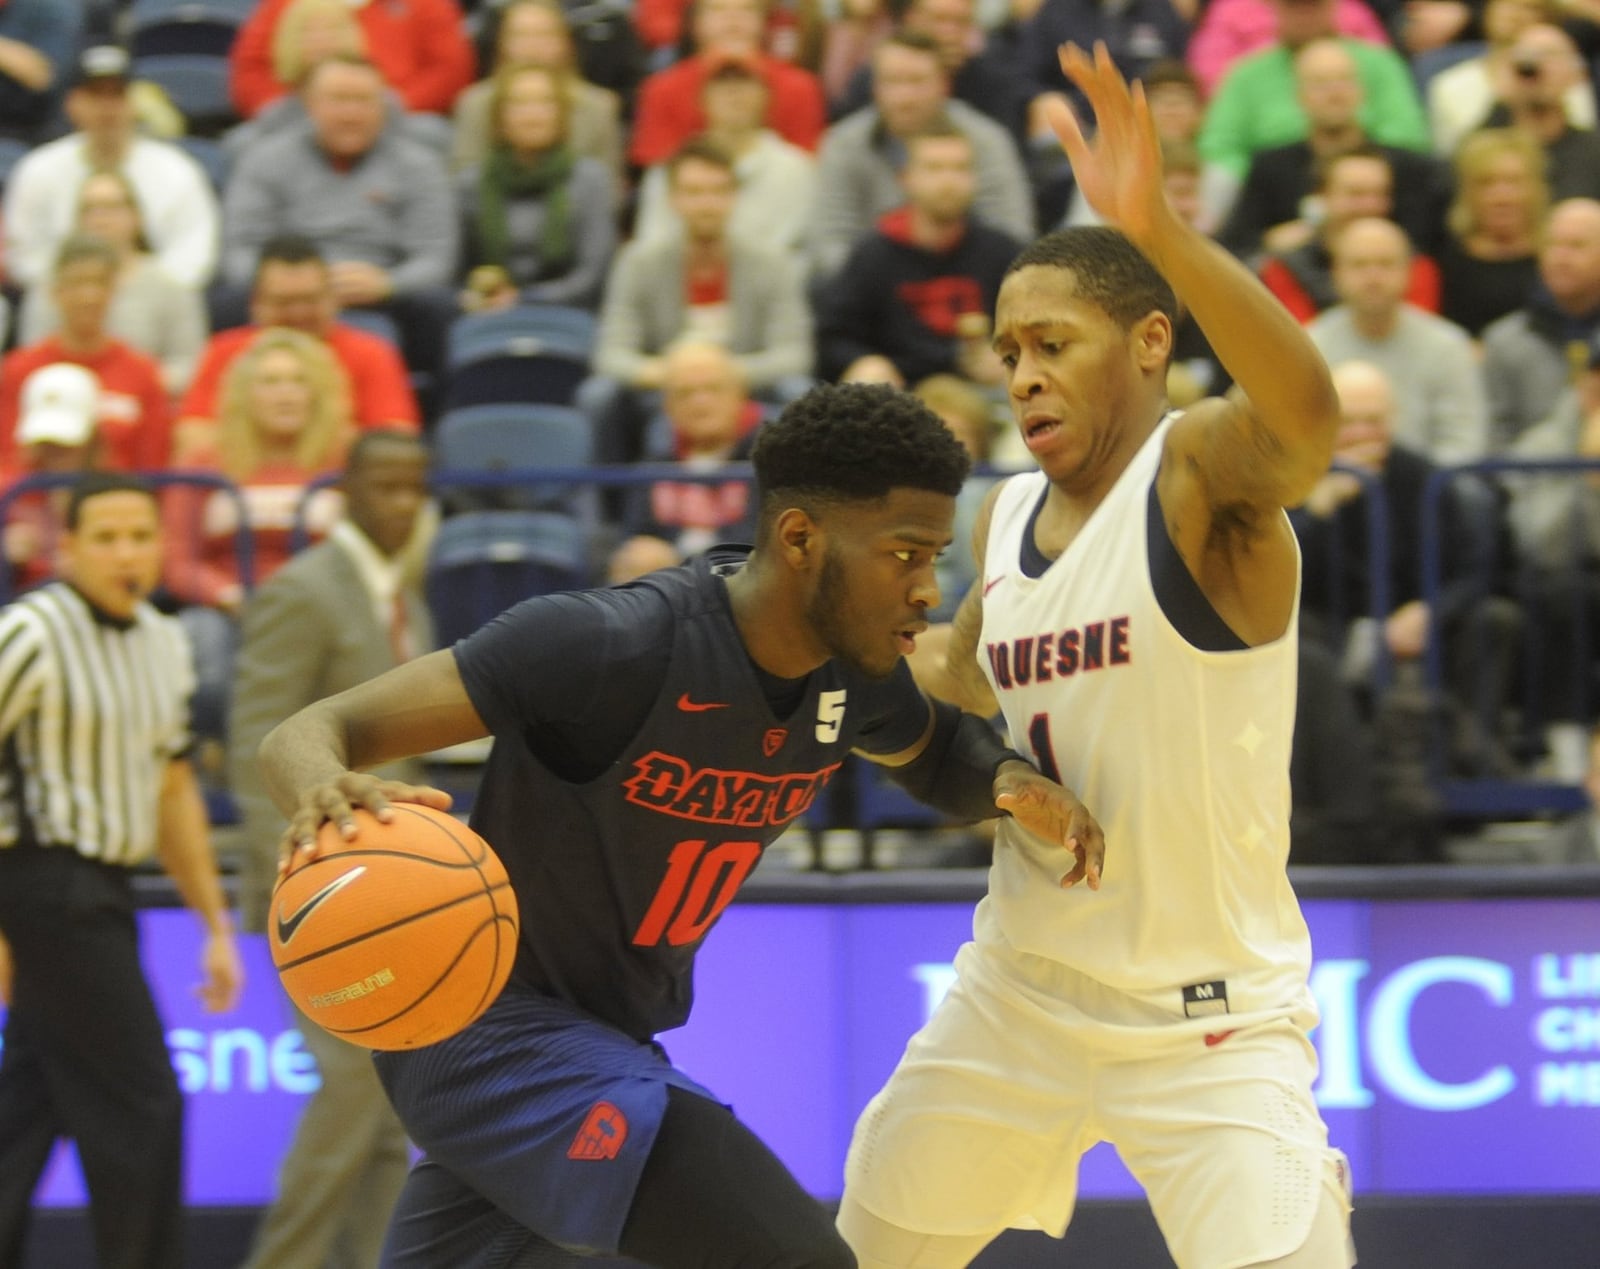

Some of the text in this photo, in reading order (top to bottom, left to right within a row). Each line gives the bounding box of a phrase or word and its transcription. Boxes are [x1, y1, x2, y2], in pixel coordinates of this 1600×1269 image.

[815, 689, 847, 743] 5
[1029, 712, 1063, 786] 1
[632, 840, 762, 946] 10
[1195, 983, 1214, 999] M
